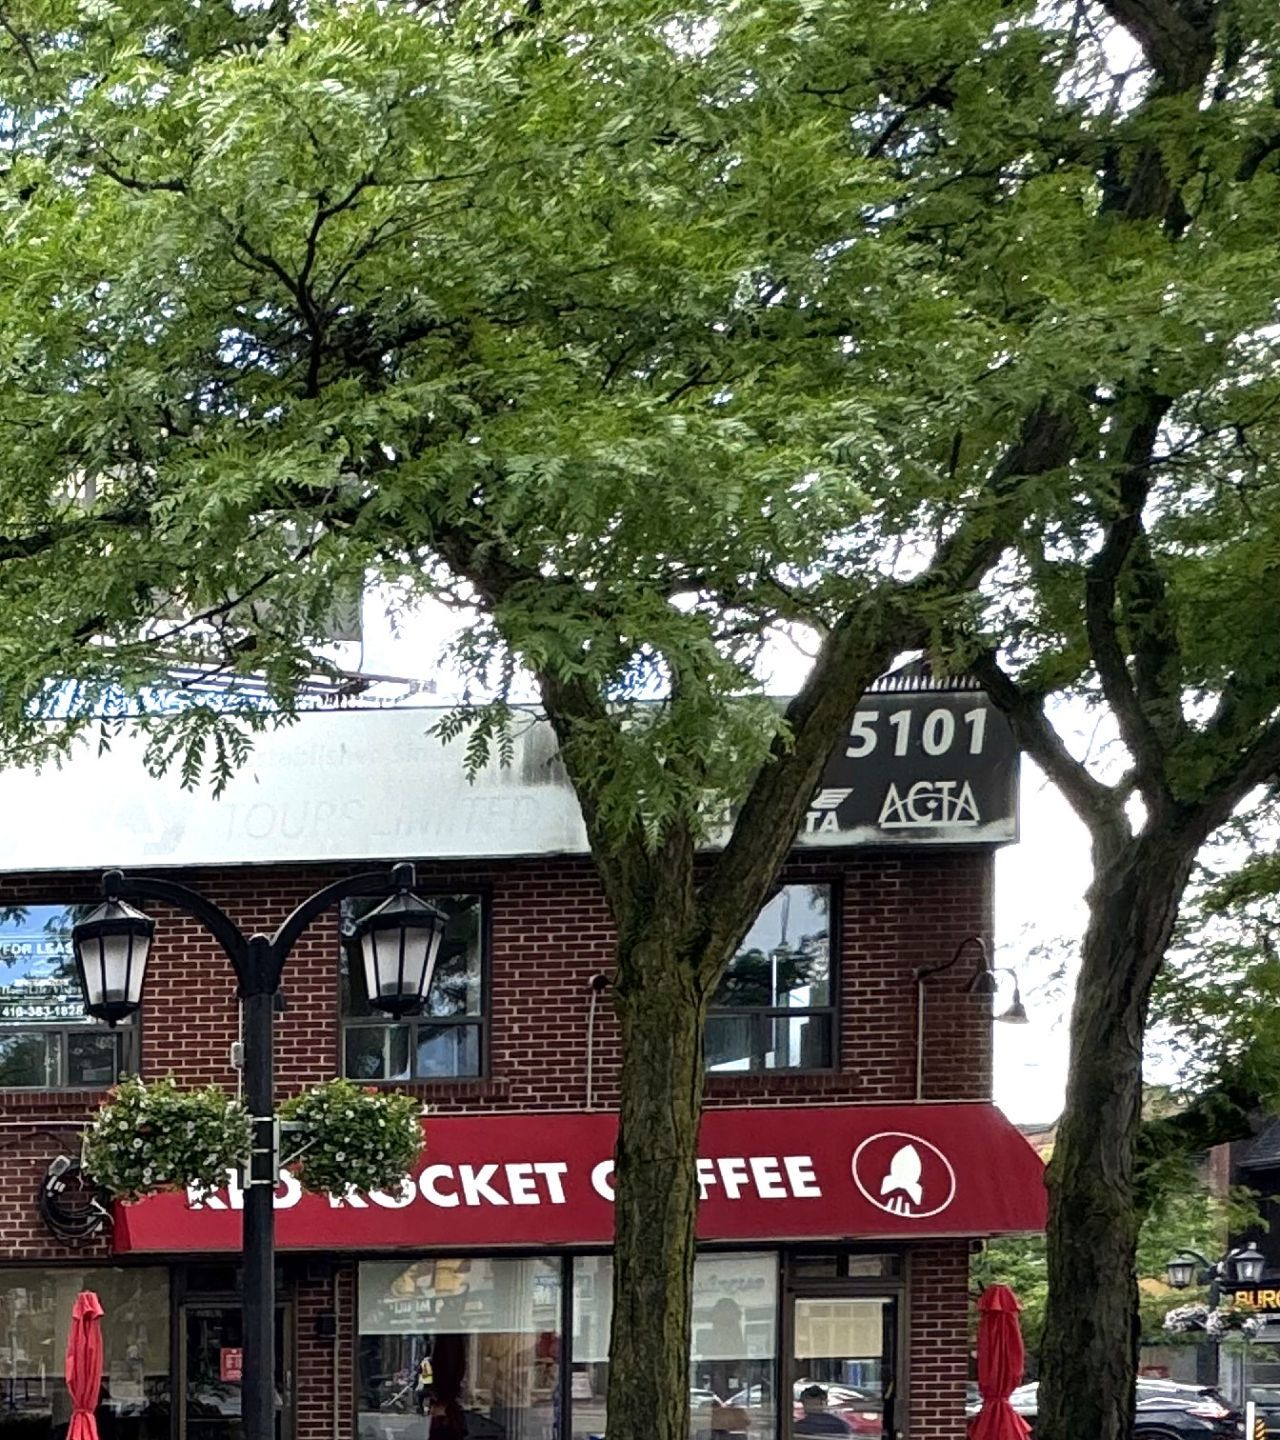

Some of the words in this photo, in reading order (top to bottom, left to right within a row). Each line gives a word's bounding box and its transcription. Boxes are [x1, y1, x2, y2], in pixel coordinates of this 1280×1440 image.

[846, 708, 987, 758] 5101
[2, 943, 32, 955] FOR
[37, 942, 74, 955] LEAS
[591, 1156, 822, 1201] CFFEE
